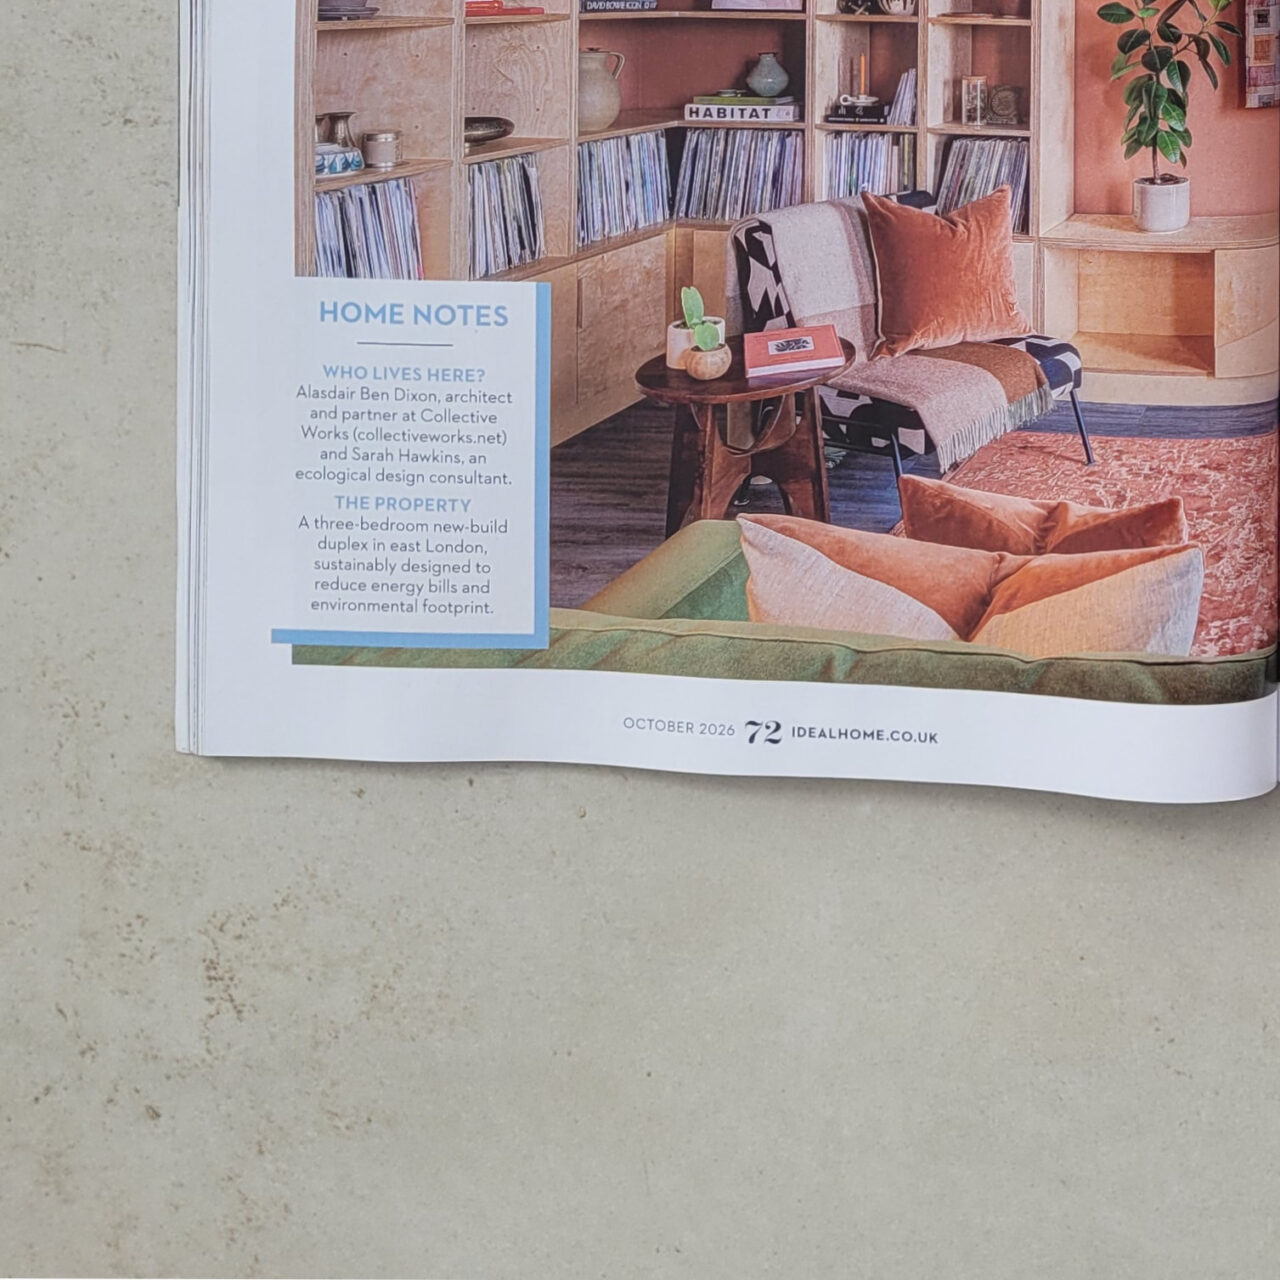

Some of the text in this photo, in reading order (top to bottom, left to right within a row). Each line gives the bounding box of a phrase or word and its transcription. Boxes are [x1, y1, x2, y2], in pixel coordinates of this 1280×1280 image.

[587, 1, 605, 9] DAVID
[688, 107, 772, 119] HABITAT
[320, 301, 508, 326] HOME NOTES
[323, 365, 485, 383] WHO LIVES HERE?
[296, 385, 512, 405] Alasdair Ben Dixon, architect
[310, 406, 497, 424] and partner at Collective
[301, 425, 507, 446] Works (collectiveworks.net)
[320, 446, 486, 465] and Sarah Hawkins, an
[295, 467, 512, 486] ecological design consultant.
[334, 495, 471, 512] THE PROPERTY
[299, 515, 507, 533] A three-bedroom new-build
[318, 537, 487, 555] duplex in east London,
[314, 558, 491, 577] sustainably designed to
[315, 578, 490, 597] reduce energy bills and
[311, 598, 493, 617] environmental footprint.
[624, 717, 938, 744] OCTOBER 2026 72 IDEALHOME.CO.UK
